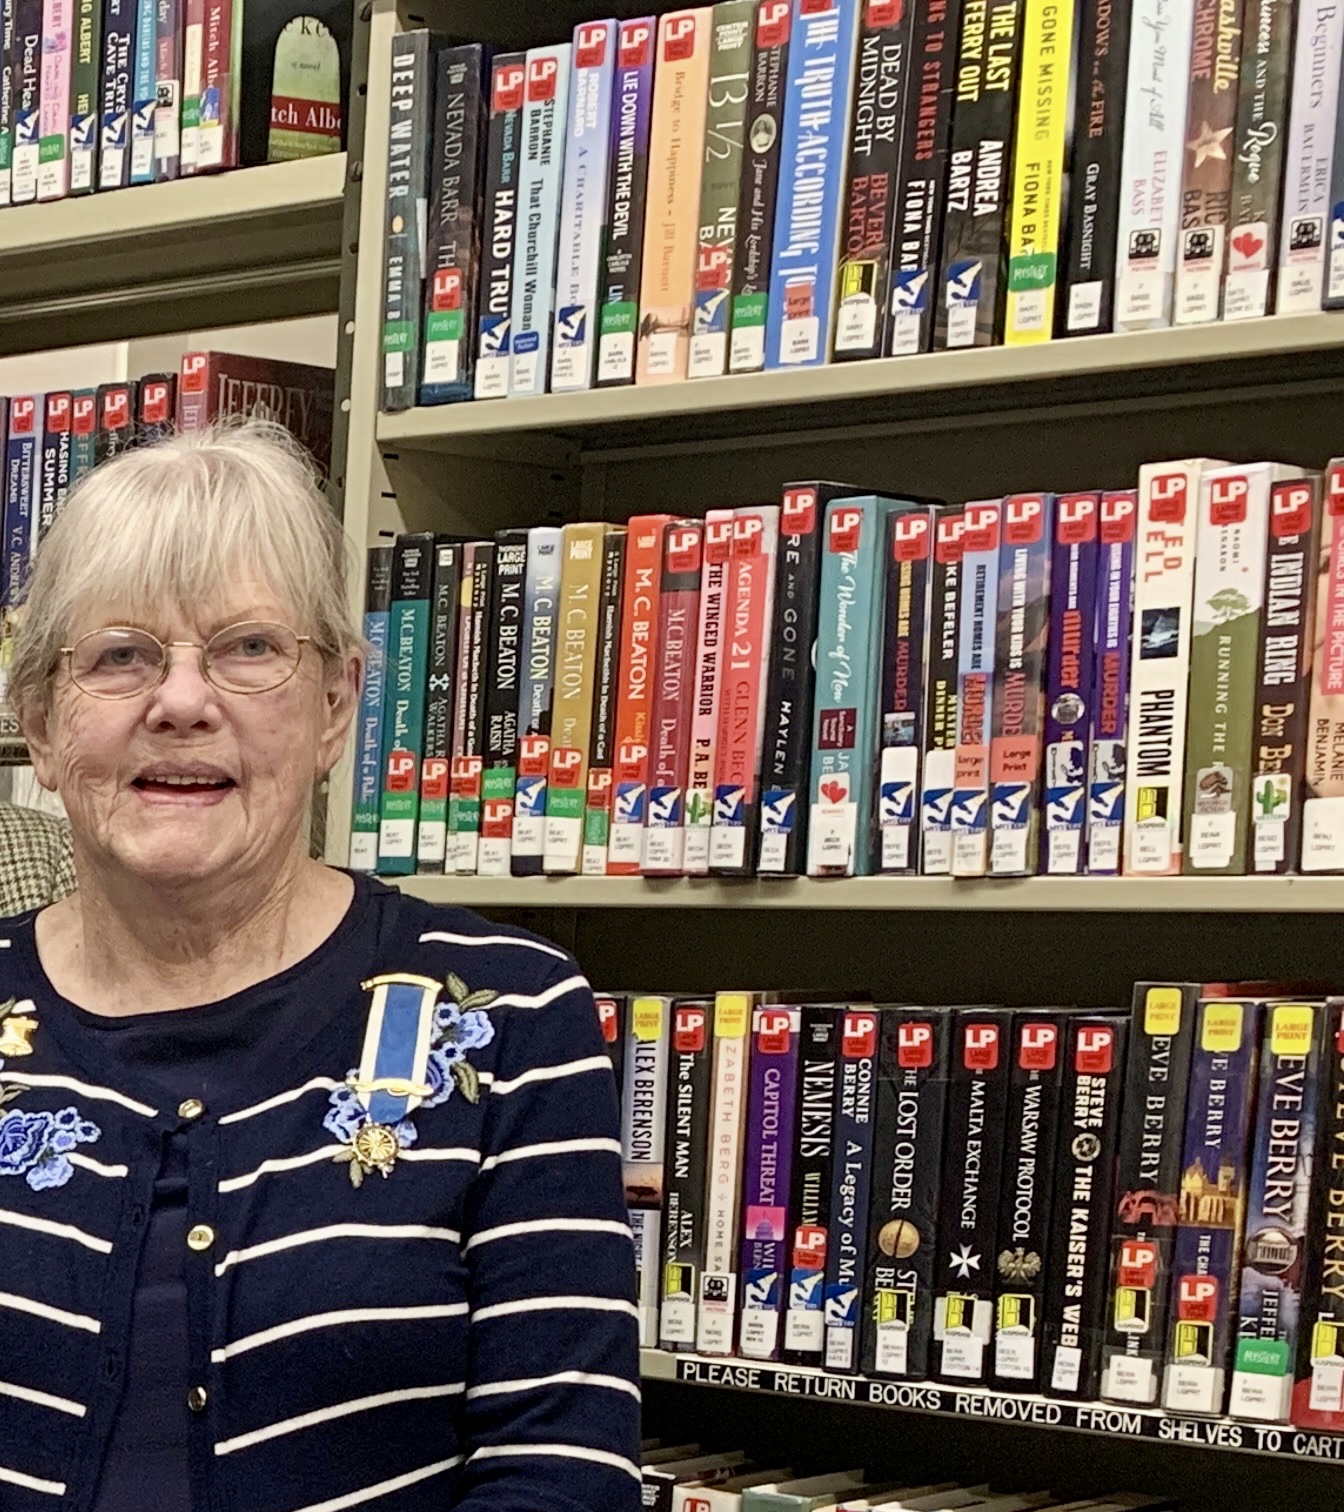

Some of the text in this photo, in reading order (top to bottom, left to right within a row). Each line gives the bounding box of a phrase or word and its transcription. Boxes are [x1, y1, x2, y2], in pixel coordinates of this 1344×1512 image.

[23, 34, 39, 77] Dead
[207, 4, 222, 52] Mitch
[985, 6, 1015, 93] THE LAST
[853, 35, 880, 157] MIDNIGHT
[875, 43, 902, 144] DEAD BY
[957, 55, 979, 102] OUT
[1034, 5, 1058, 141] GONE MISSING
[388, 53, 415, 200] DEEP WATER
[438, 92, 465, 227] NEVADA BARR
[948, 149, 973, 213] BARTZ
[973, 140, 1004, 218] ANDREA
[492, 190, 515, 260] HARD
[521, 178, 544, 331] That Churchill Woman
[784, 495, 814, 513] LP
[1007, 501, 1040, 522] LP
[496, 624, 519, 691] BEATON
[697, 591, 720, 716] WINGED WARRIOR
[730, 561, 753, 670] AGENDA 21
[627, 618, 648, 699] BEATON
[1213, 635, 1232, 715] RUNNING
[1002, 748, 1032, 760] Large
[1002, 760, 1028, 772] Print
[1136, 689, 1175, 778] PHANTOM
[674, 1053, 695, 1178] The SILENT MAN
[799, 1060, 835, 1158] NEMESIS
[841, 1063, 857, 1117] BERRY
[855, 1059, 872, 1123] CONNIE
[1075, 1075, 1091, 1129] BERRY
[1088, 1077, 1106, 1128] STEVE
[759, 1069, 781, 1207] CAPITOL THREAT
[891, 1090, 919, 1211] LOST ORDER
[1013, 1084, 1042, 1242] WARSAW PROTOCOL
[1061, 1166, 1093, 1347] THE KAISER'S WEB
[682, 1364, 1344, 1456] PLEASE RETURN BOOKS REMOVED FROM SHELVES TO CART
